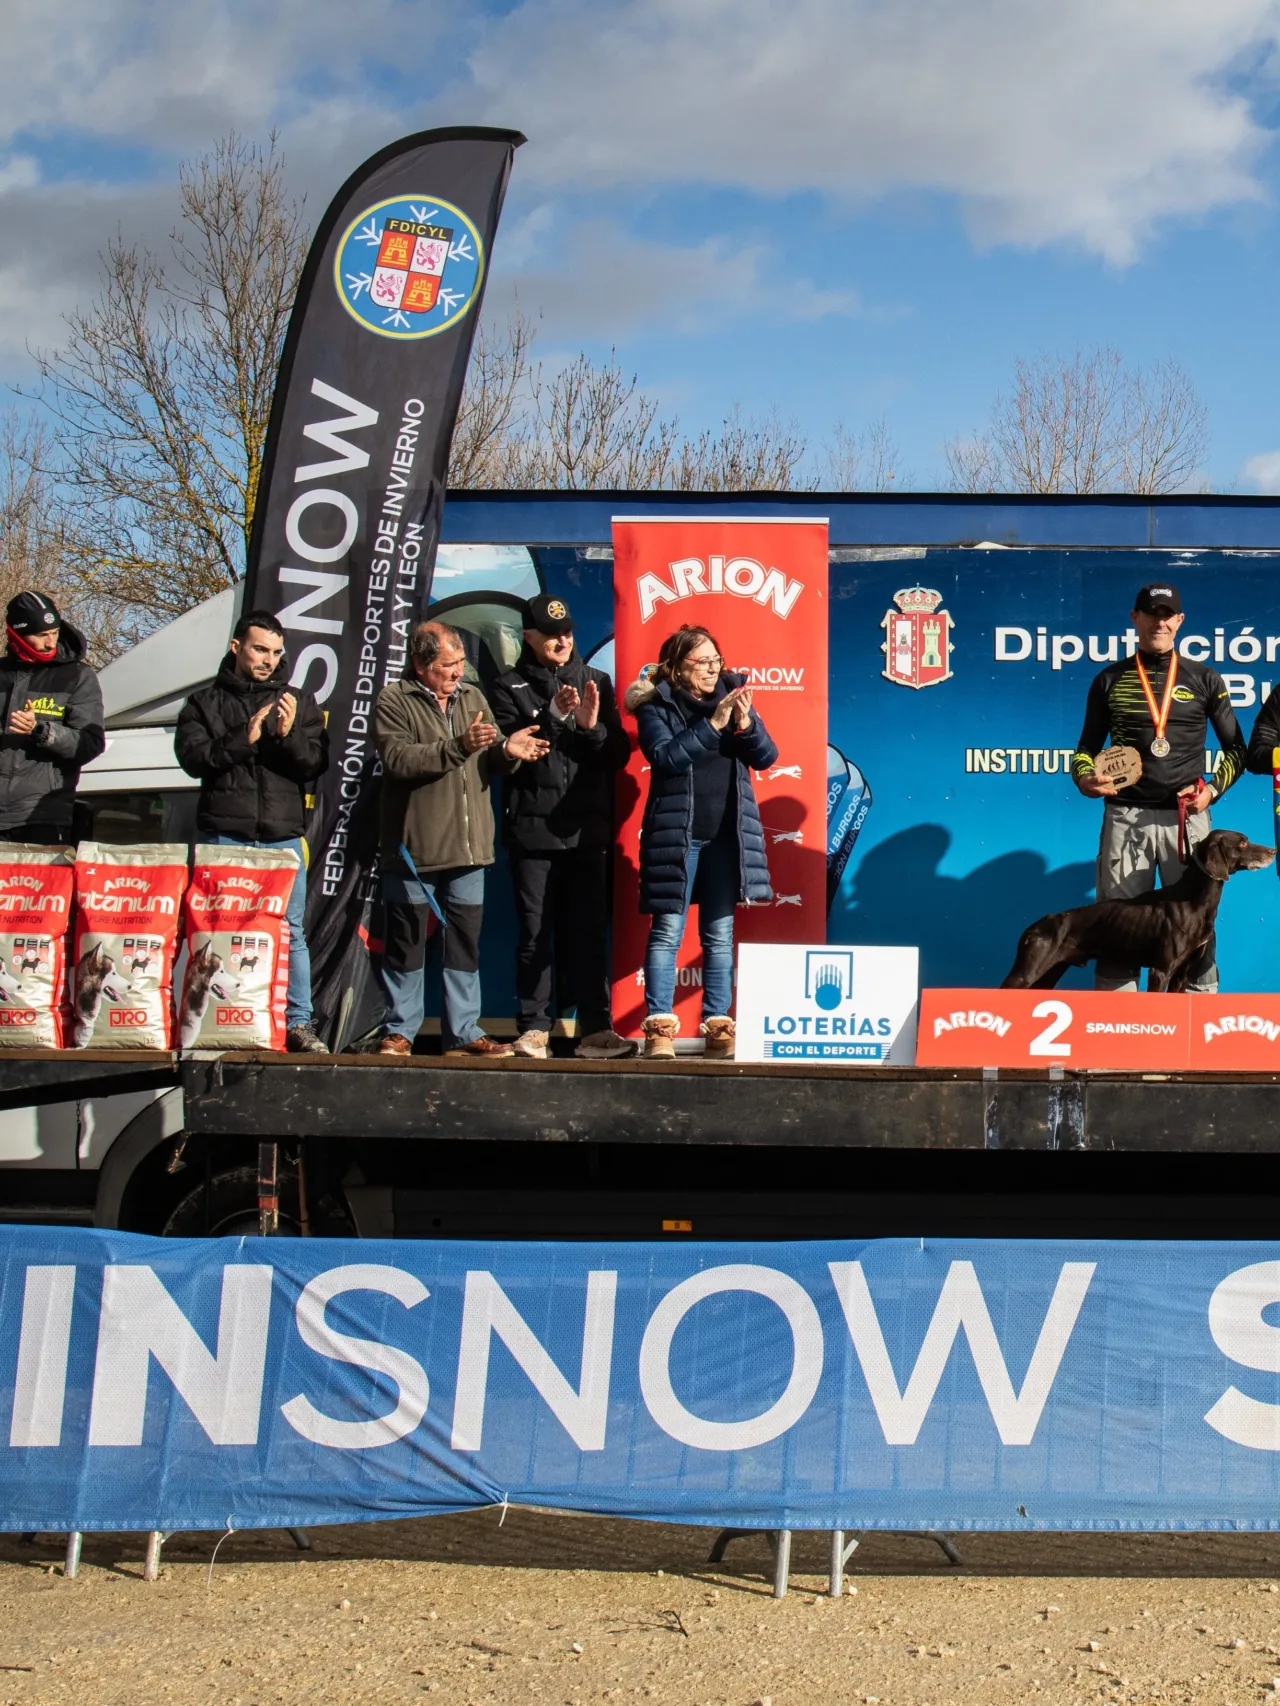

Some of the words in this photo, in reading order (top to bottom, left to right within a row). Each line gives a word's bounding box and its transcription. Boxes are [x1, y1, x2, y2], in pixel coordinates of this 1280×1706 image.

[389, 219, 447, 239] FDICYL
[382, 398, 425, 517] INVIERNO
[374, 520, 399, 554] DE
[398, 523, 425, 591] LEÓN
[395, 594, 413, 611] Y
[637, 555, 804, 624] ARION
[355, 559, 391, 695] DEPORTES
[383, 618, 411, 687] TILLA
[349, 701, 371, 733] DE
[965, 749, 1074, 774] INSTITUT
[322, 739, 367, 896] FEDERACIÓN
[103, 877, 151, 893] ARION
[217, 877, 263, 894] ARION
[764, 1013, 891, 1036] LOTERÍAS
[933, 1010, 1012, 1039] ARION
[1029, 1000, 1073, 1056] 2
[1085, 1022, 1177, 1036] SPAINSNOW
[777, 1044, 803, 1056] CON
[806, 1045, 820, 1056] EL
[823, 1046, 877, 1056] DEPORTE
